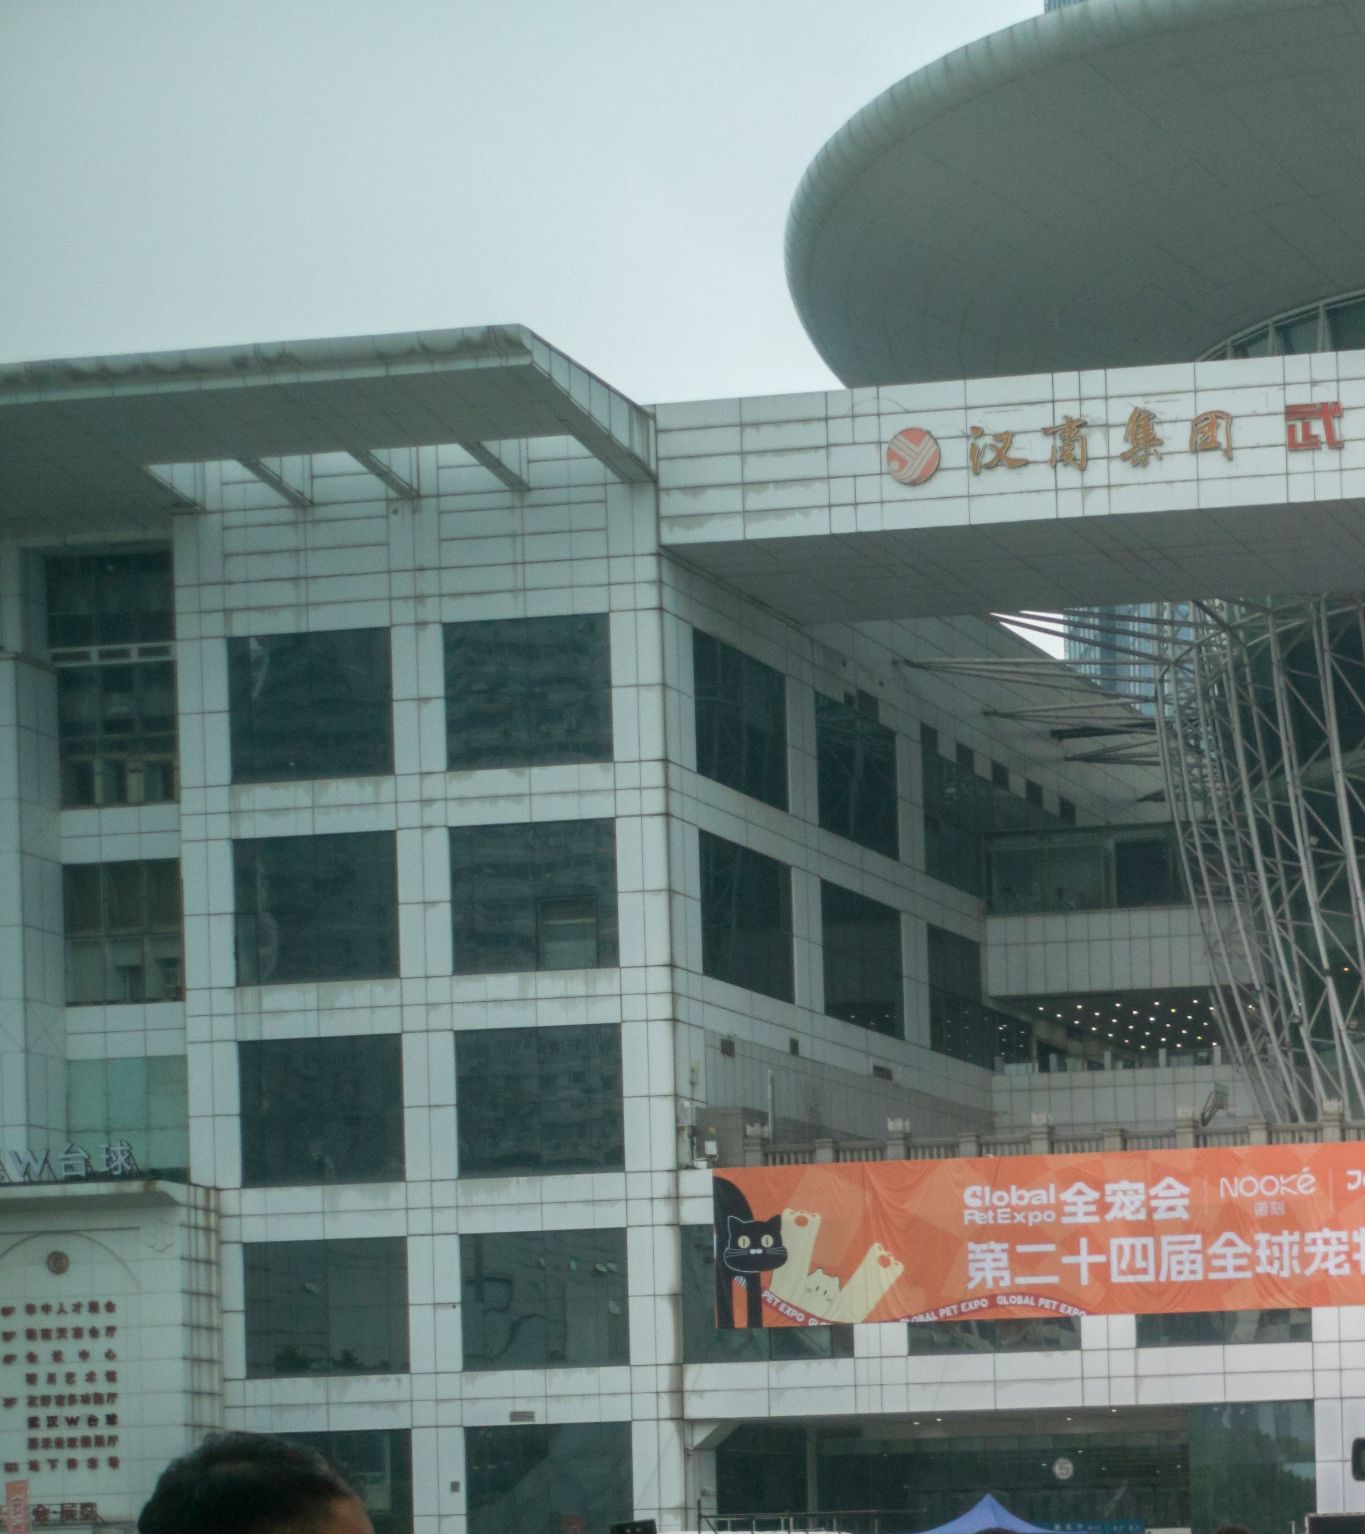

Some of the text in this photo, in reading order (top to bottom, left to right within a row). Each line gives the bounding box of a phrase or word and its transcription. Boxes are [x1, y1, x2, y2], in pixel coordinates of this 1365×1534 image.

[968, 404, 1236, 475] 汉商集团
[963, 1184, 1056, 1209] Global
[1060, 1176, 1191, 1225] 全宠会
[996, 1295, 1036, 1306] GLOBAL
